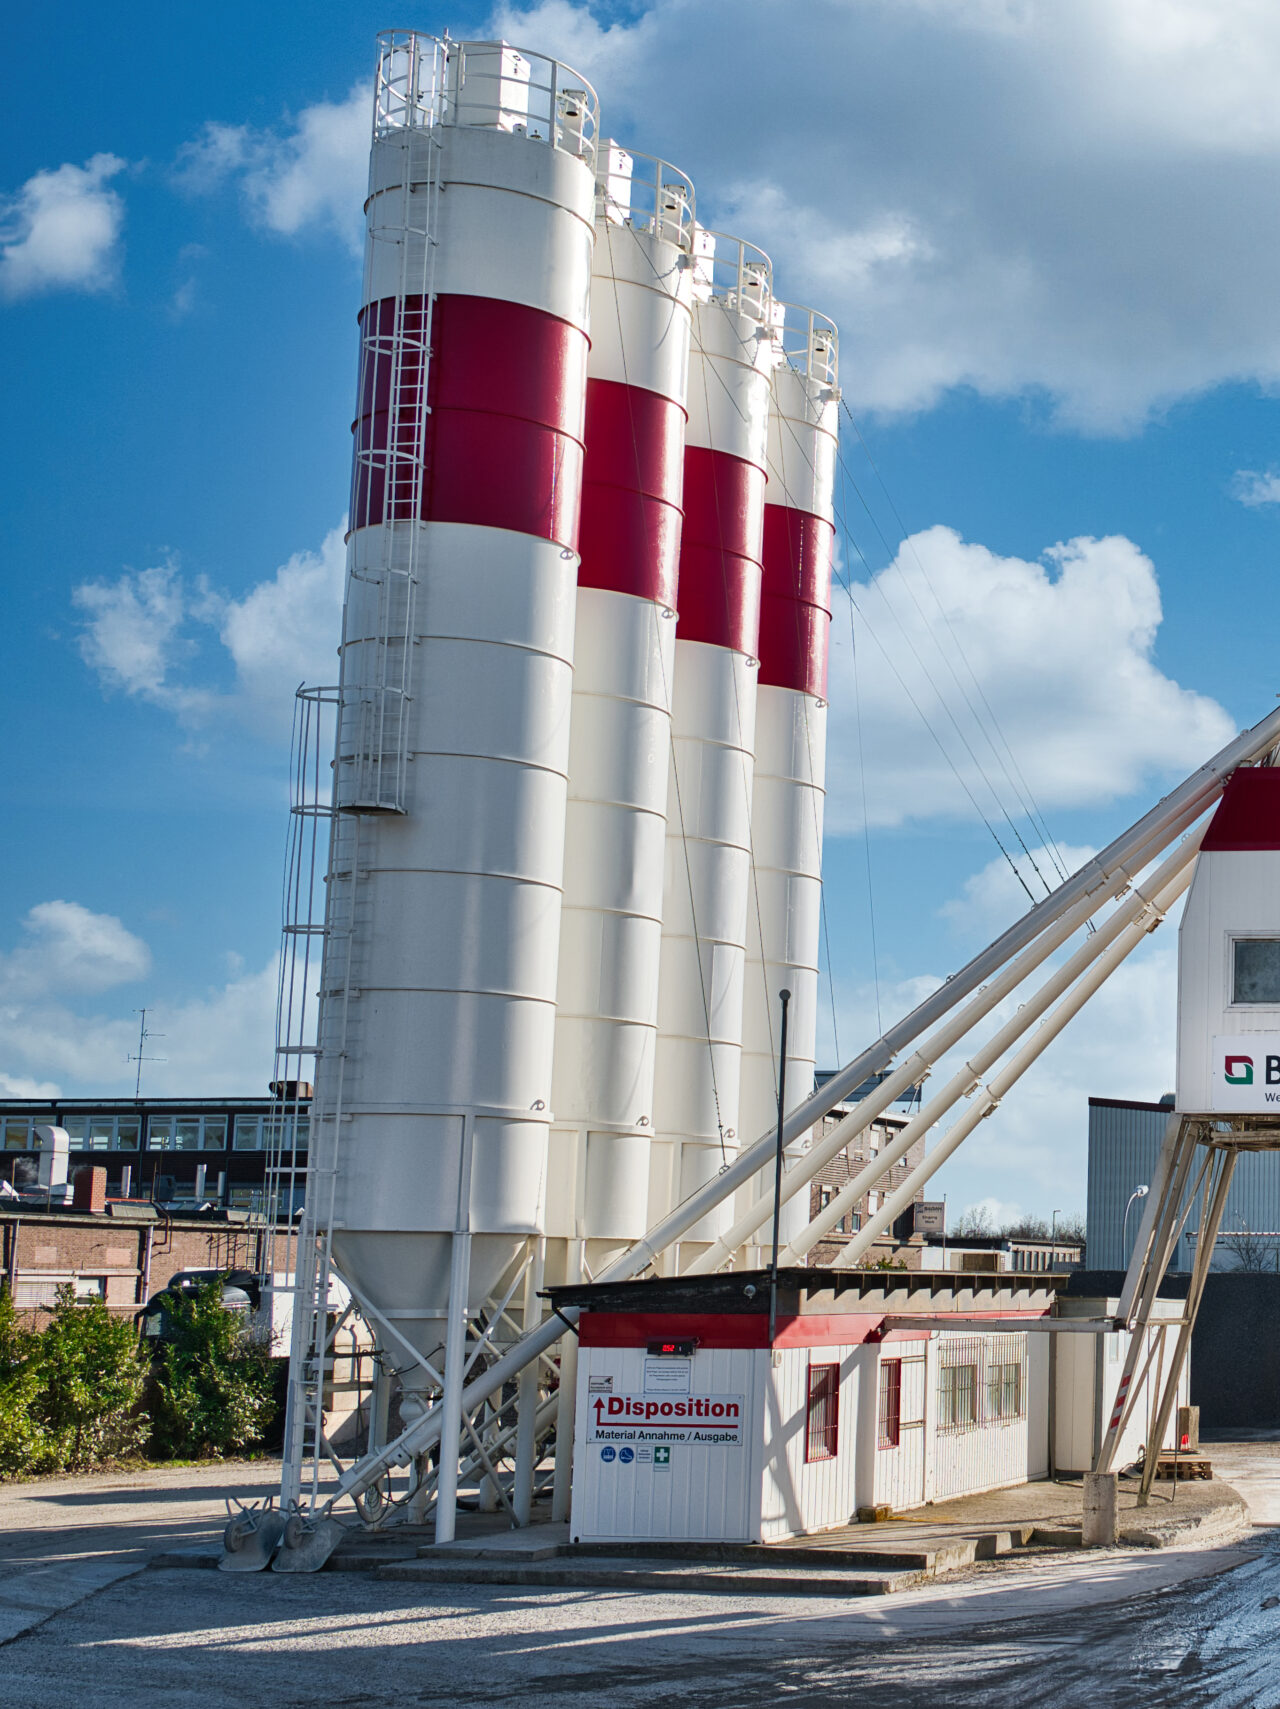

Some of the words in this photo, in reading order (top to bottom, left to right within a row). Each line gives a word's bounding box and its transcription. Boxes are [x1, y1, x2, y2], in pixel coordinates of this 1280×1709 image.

[607, 1397, 739, 1419] Disposition
[595, 1429, 636, 1441] Material
[638, 1430, 685, 1441] Annahme
[693, 1431, 738, 1443] Ausgabe
